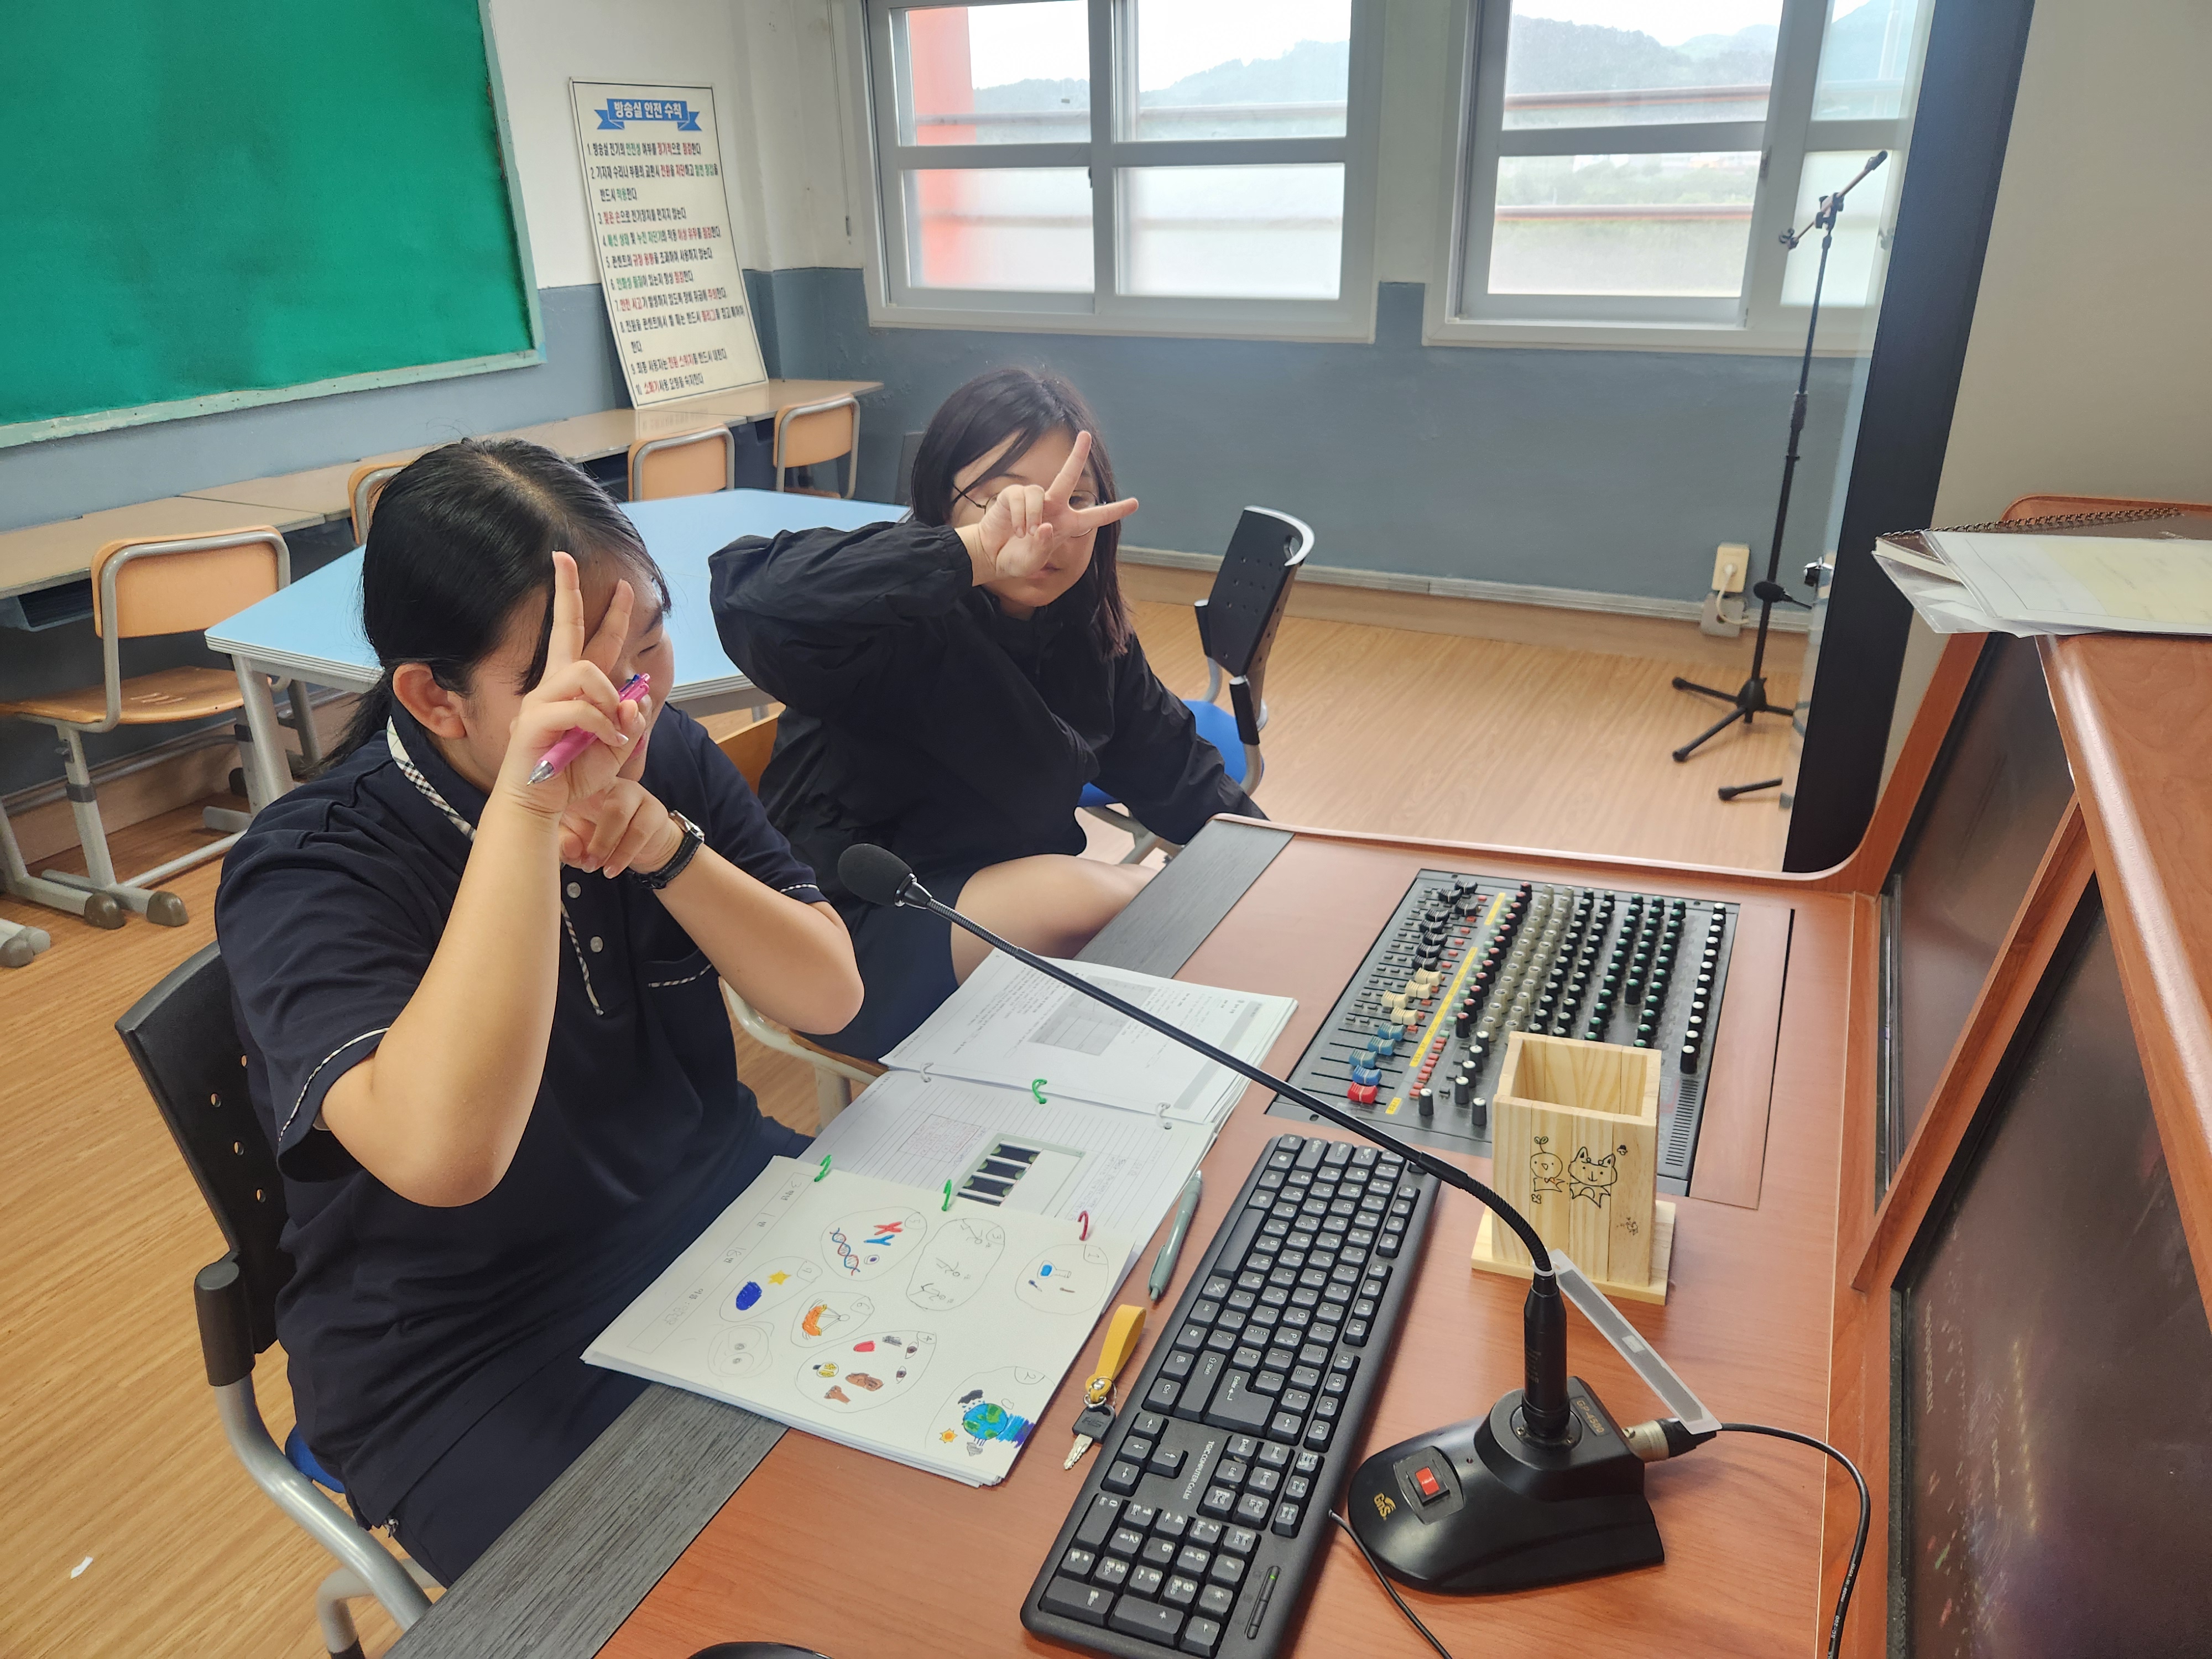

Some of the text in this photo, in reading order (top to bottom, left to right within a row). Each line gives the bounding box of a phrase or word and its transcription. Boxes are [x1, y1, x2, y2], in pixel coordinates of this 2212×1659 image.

[614, 102, 682, 119] 방송실 안전 수칙
[593, 142, 609, 156] 방송실
[599, 188, 616, 202] 반드시
[615, 210, 631, 223] 손으로
[1191, 1454, 1207, 1482] COMPUTER
